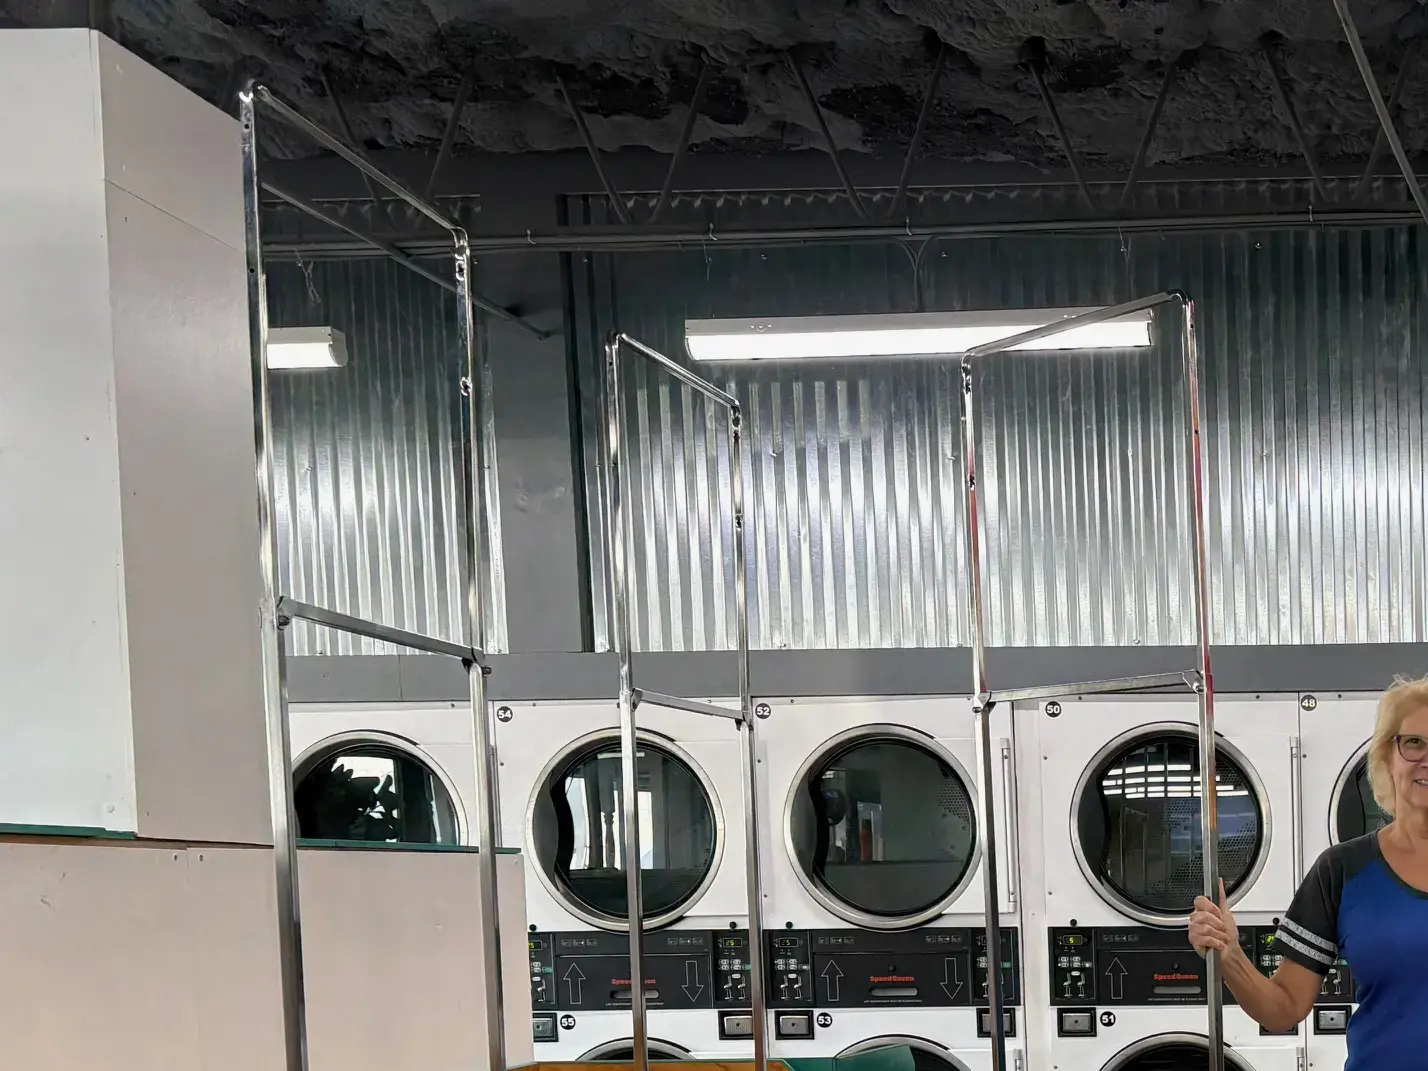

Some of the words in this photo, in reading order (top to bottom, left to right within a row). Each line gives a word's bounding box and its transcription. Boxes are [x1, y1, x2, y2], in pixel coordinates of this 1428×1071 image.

[1301, 698, 1316, 708] 48
[497, 709, 512, 719] 54
[756, 706, 770, 716] 52
[1046, 704, 1060, 714] 50
[561, 1017, 575, 1027] 55
[817, 1015, 832, 1025] 53
[1101, 1014, 1115, 1024] 51
